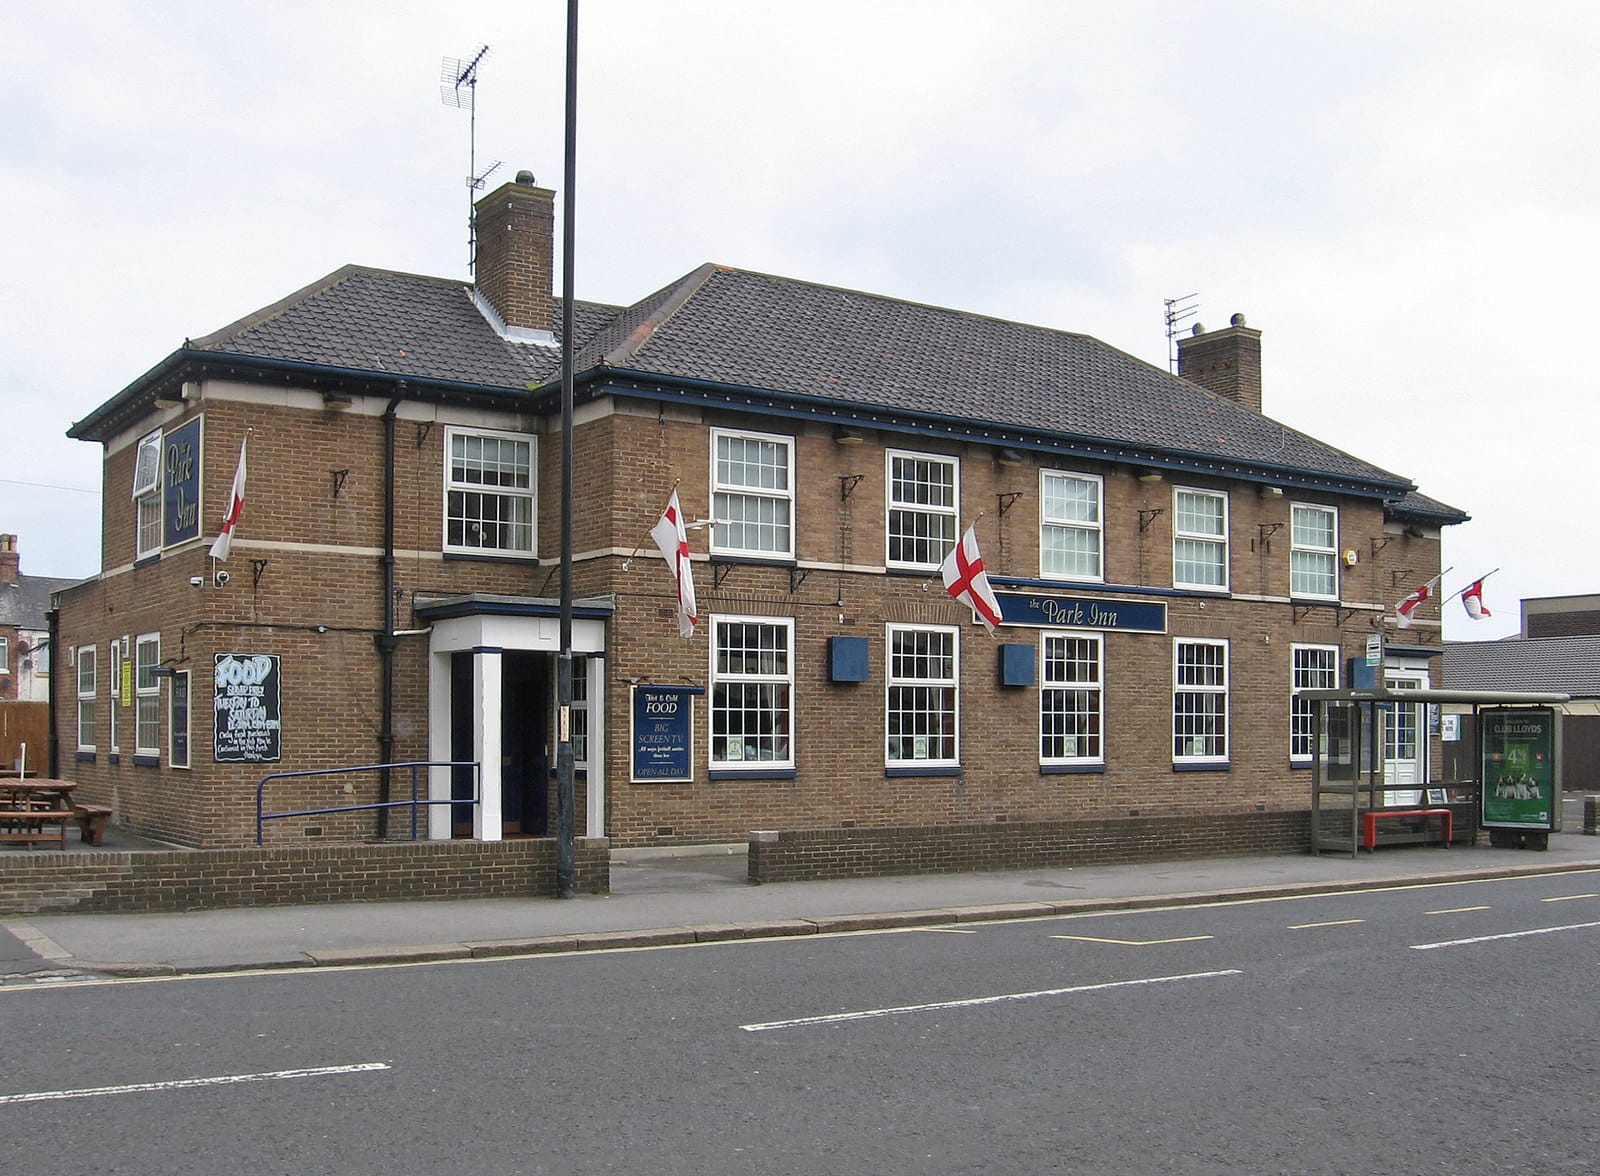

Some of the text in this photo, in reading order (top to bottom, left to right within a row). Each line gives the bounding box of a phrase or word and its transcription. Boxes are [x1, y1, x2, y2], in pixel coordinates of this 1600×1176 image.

[168, 443, 192, 488] Park
[175, 486, 196, 532] Inn
[1029, 599, 1118, 626] the Park Inn
[215, 655, 272, 688] FOOD
[248, 696, 260, 708] TO
[646, 702, 677, 713] FOOD
[654, 723, 669, 732] BIG
[1494, 724, 1542, 734] CLUB LLOYDS
[638, 734, 670, 744] SCREEN
[637, 767, 685, 776] OPEN ALL DAY
